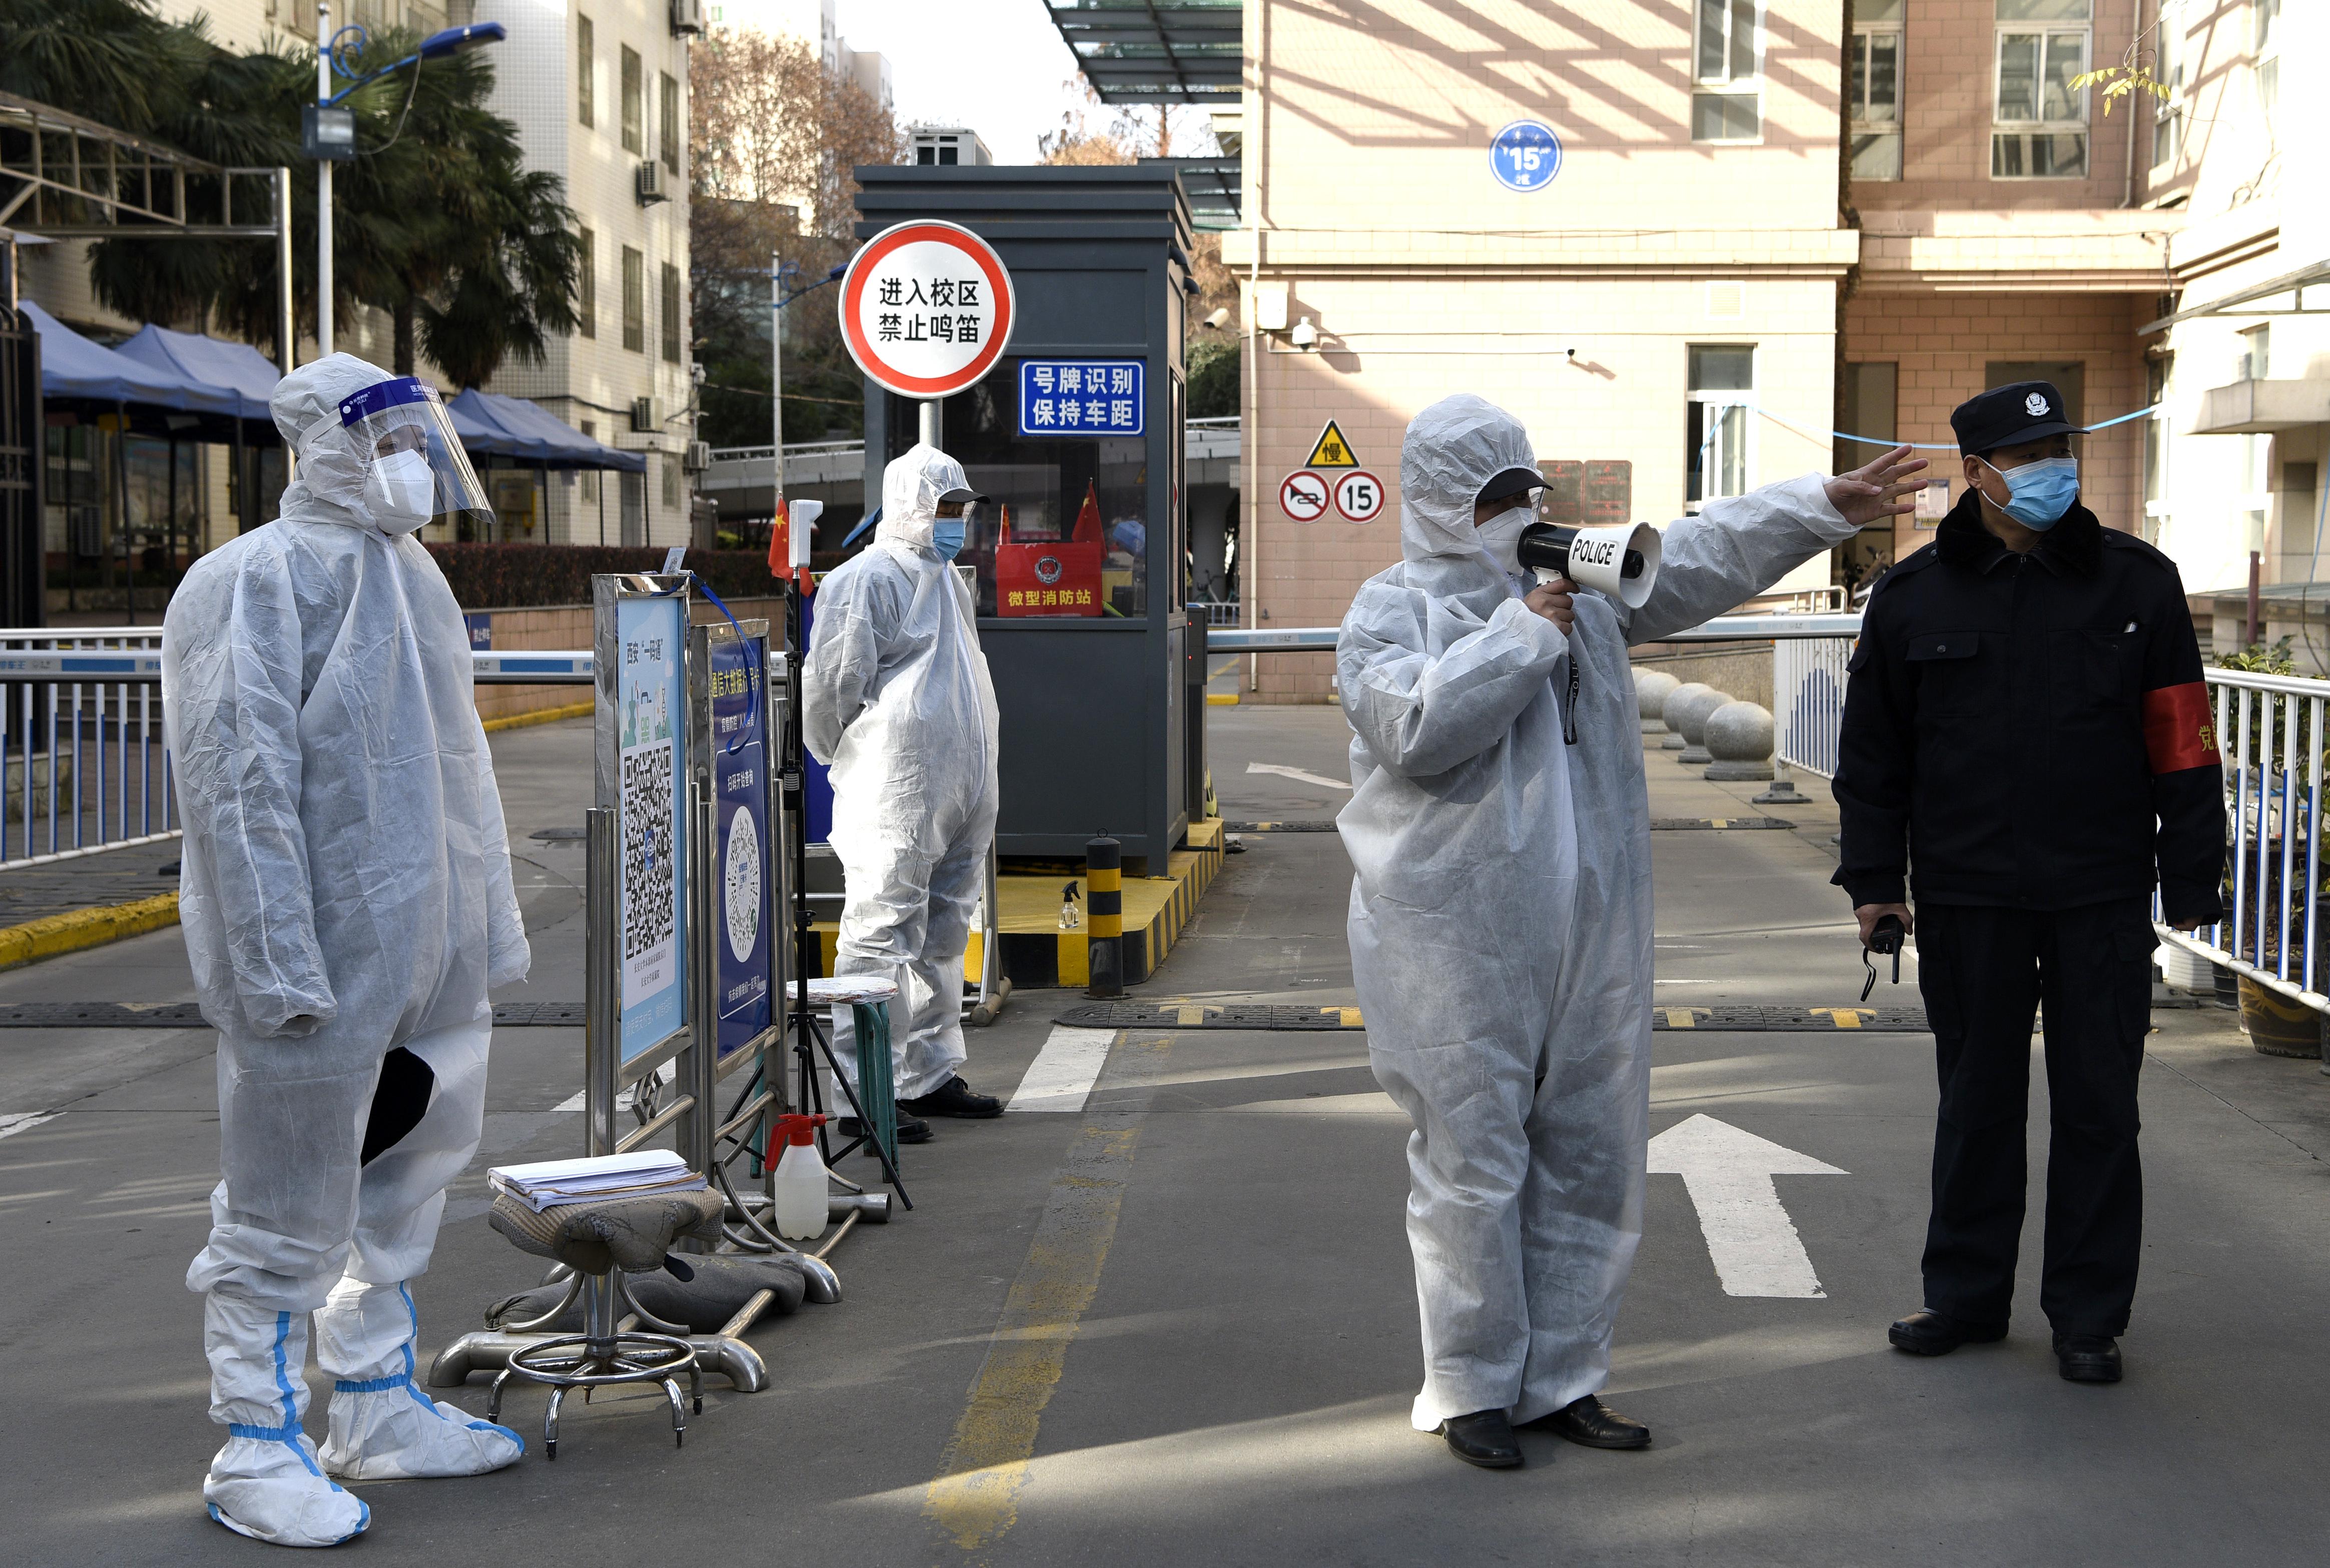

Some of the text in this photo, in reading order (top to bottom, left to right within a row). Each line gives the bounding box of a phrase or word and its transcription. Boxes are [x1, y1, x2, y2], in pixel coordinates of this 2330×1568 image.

[1509, 147, 1540, 171] 15
[879, 278, 980, 307] 进入校区
[878, 313, 981, 343] 禁止鸣笛
[1033, 367, 1132, 394] 号牌识别
[1033, 398, 1133, 426] 保持车距
[1322, 443, 1341, 463] 慢
[1347, 485, 1372, 510] 15
[1572, 539, 1615, 566] POLICE
[1008, 589, 1091, 607] 微型消防站
[721, 715, 738, 733] 疫情防控
[727, 768, 754, 793] 扫码开始查询
[728, 973, 760, 1003] 抗击疫情我们一起努力
